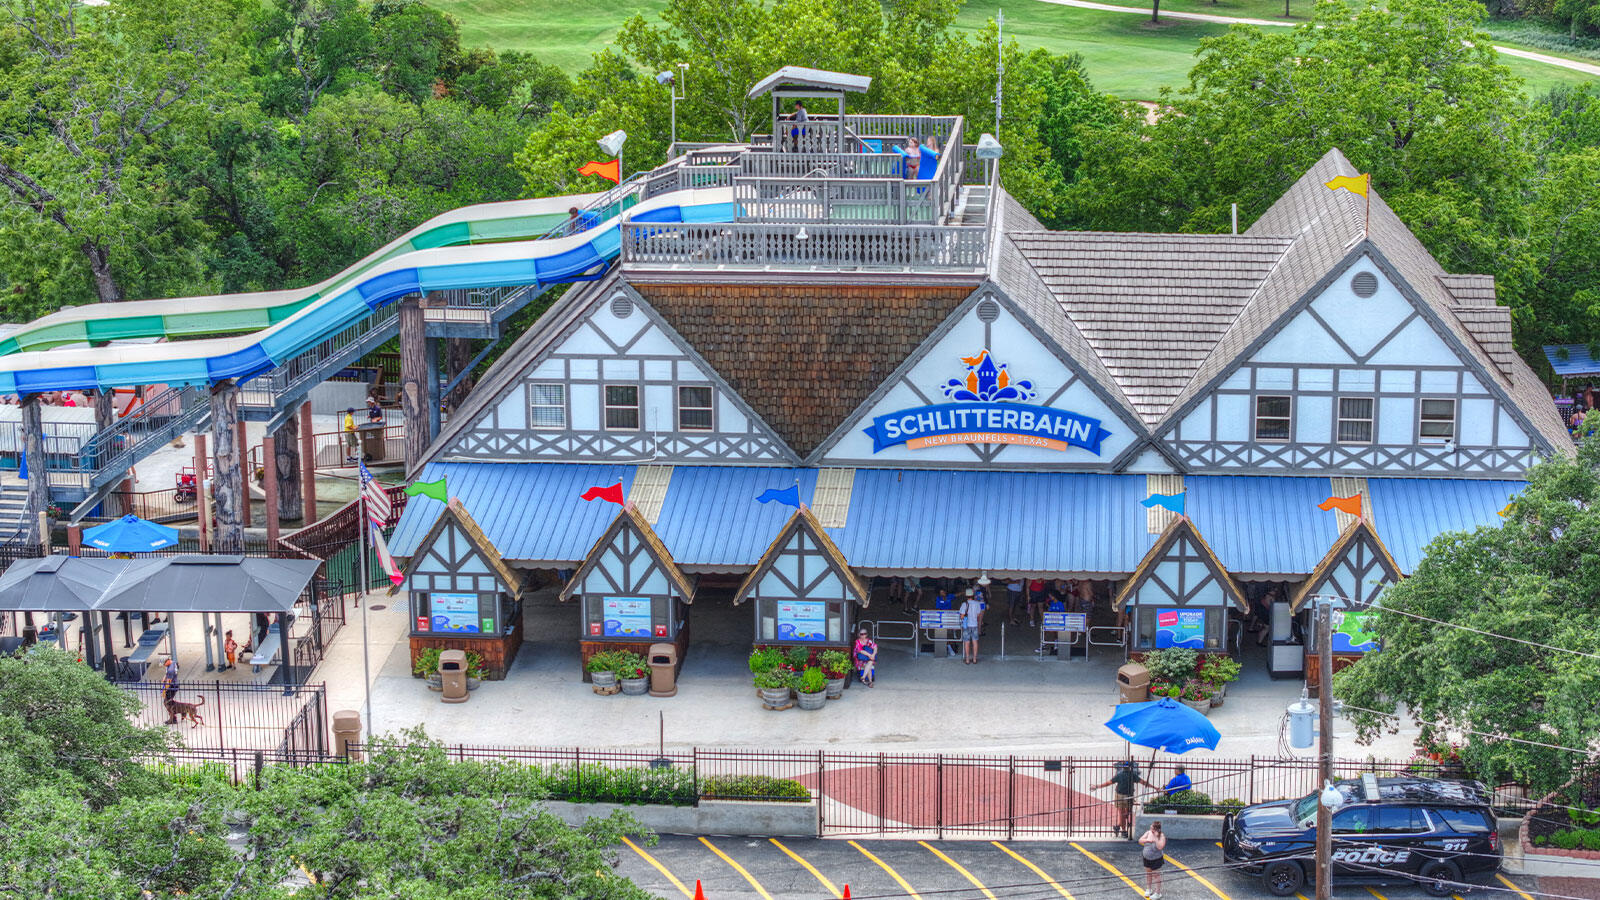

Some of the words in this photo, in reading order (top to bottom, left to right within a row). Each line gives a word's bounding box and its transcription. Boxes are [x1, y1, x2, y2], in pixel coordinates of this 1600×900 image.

[884, 408, 1092, 442] SCHLITTERBAHN
[924, 436, 946, 447] NEW
[951, 434, 1008, 443] BRAUNFELS
[1018, 436, 1049, 447] TEXAS
[1443, 843, 1468, 851] 911
[1331, 851, 1411, 863] POLICE
